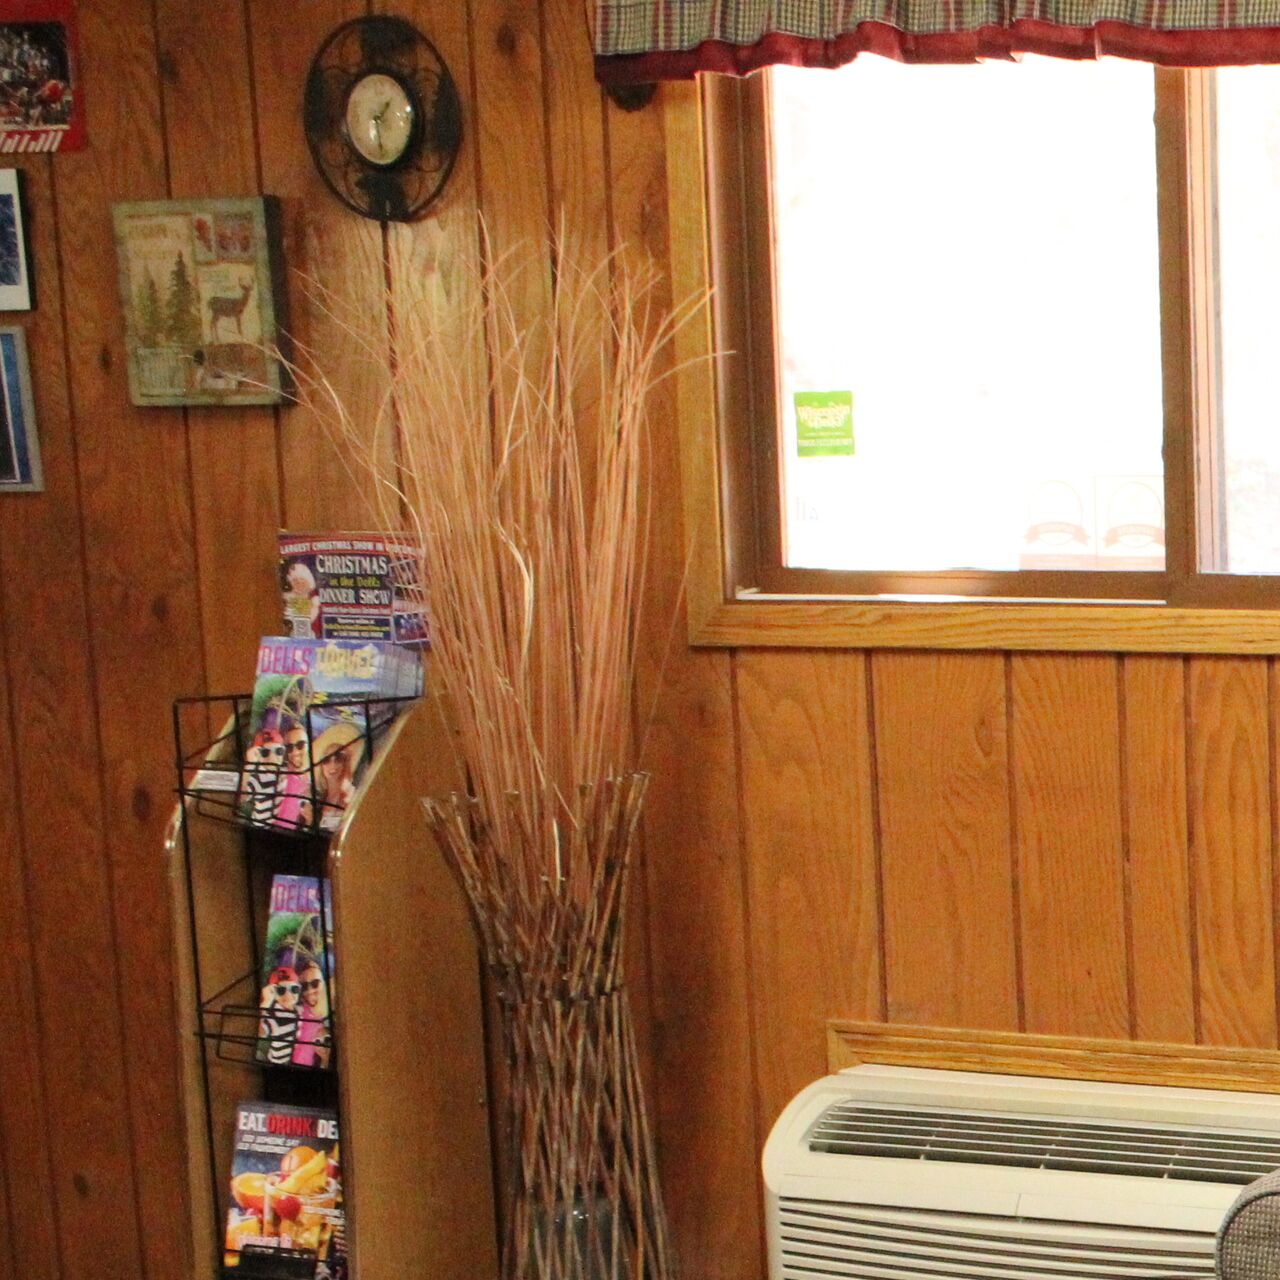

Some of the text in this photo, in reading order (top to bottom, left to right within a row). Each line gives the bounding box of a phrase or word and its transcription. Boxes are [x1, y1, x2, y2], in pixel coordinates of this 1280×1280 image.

[313, 541, 352, 551] CHRISTMAS
[314, 554, 390, 575] CHRISTMAS
[339, 576, 354, 586] the
[356, 576, 381, 588] Dells
[318, 588, 391, 605] DINNER SHOW
[259, 645, 312, 676] DELLS
[273, 883, 321, 913] DELL
